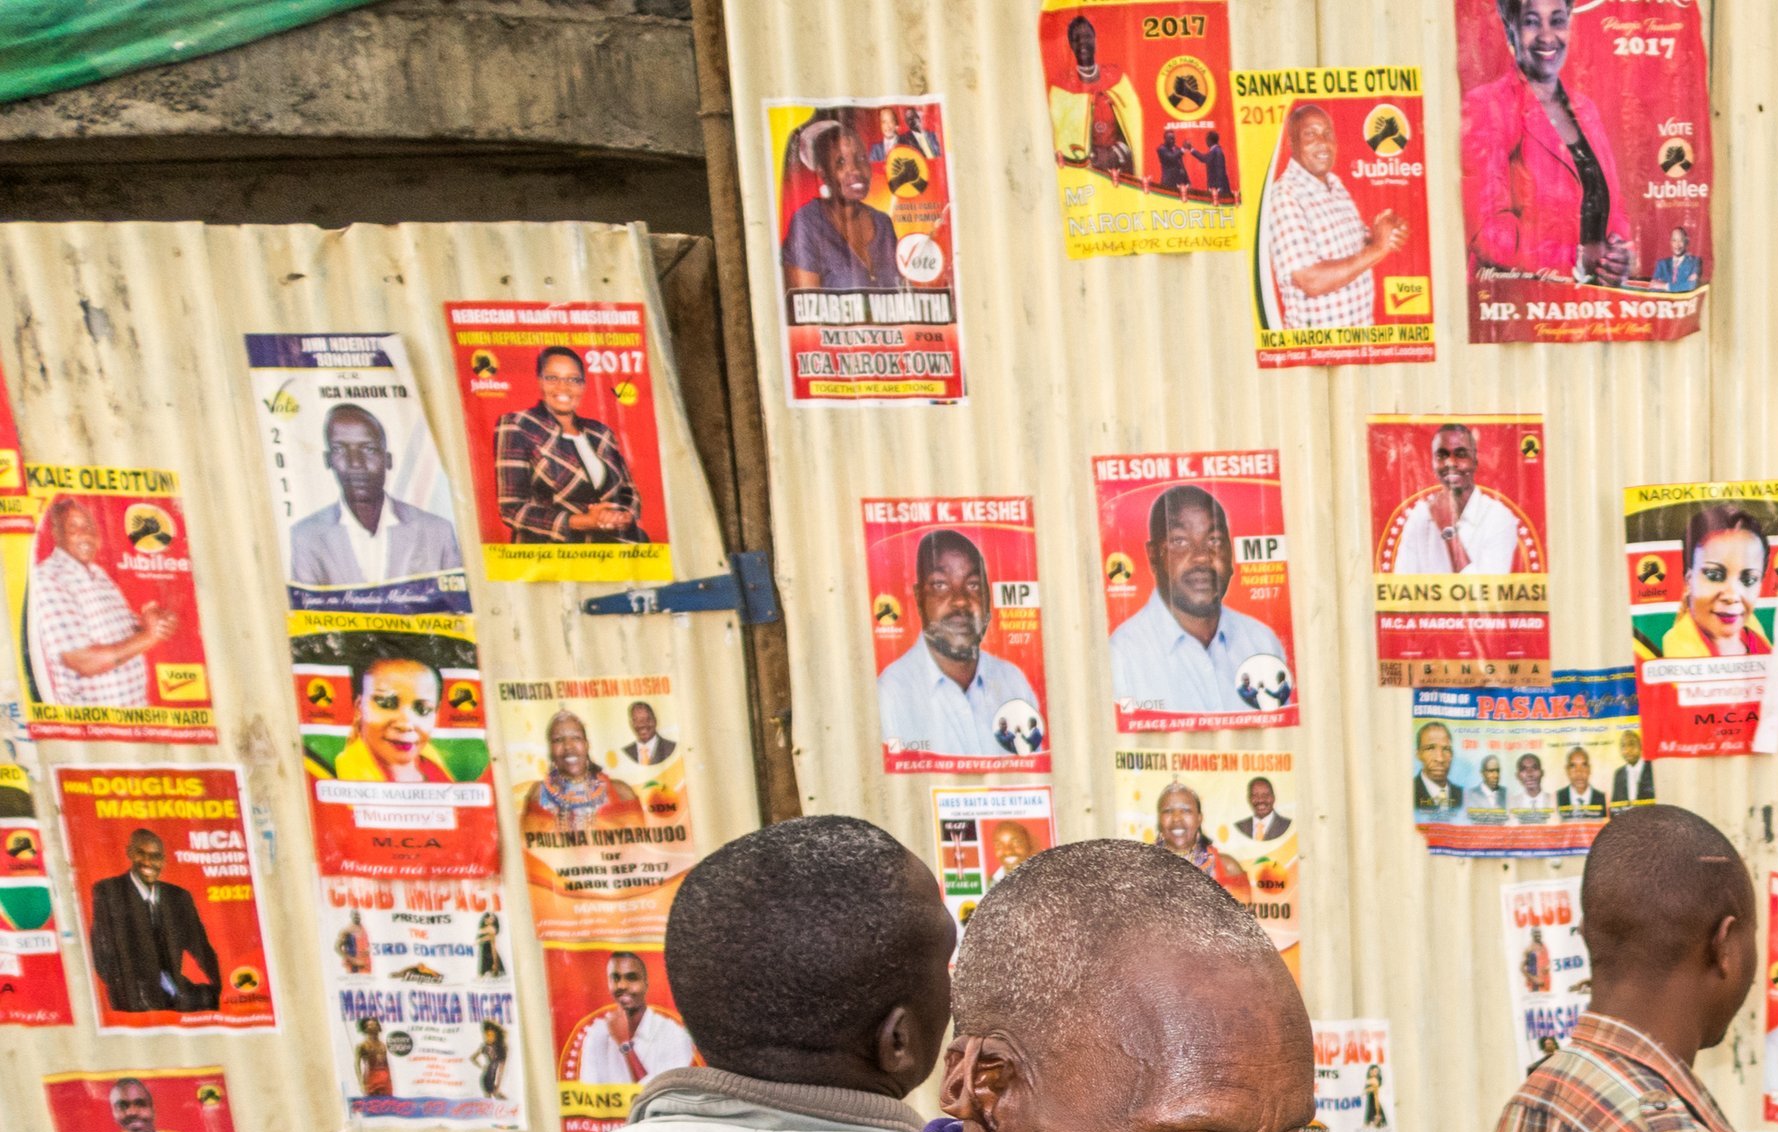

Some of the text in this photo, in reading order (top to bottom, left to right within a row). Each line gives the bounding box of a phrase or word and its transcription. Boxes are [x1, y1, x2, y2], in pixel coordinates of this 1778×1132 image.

[1143, 15, 1206, 39] 2017
[1612, 37, 1676, 59] 2017
[1235, 68, 1418, 98] SANKALE OLE OTUNI
[1240, 105, 1285, 125] 2017
[1164, 120, 1216, 131] JUBILEE
[1657, 117, 1694, 137] VOTE
[1351, 157, 1424, 178] Jubilee
[1065, 185, 1096, 208] MP
[1643, 180, 1709, 199] Jubilee
[1068, 207, 1236, 238] NAROK NORTH
[1396, 282, 1423, 294] Vote
[1479, 298, 1699, 322] MP. NAROK NORTH
[821, 330, 944, 348] MUNYUA FOR
[1260, 325, 1430, 348] MCA NAROK TOWNSHIP WARD
[585, 350, 645, 373] 2017
[1097, 453, 1275, 481] NELSON K. KESHEI
[864, 499, 1028, 524] NELSON K. KESHEI
[1243, 537, 1279, 561] MP
[117, 553, 191, 572] Jubilee
[1002, 583, 1031, 605] MP
[1249, 586, 1281, 600] 2017
[1376, 583, 1546, 602] EVANS OLE MASI
[1380, 616, 1545, 630] M.C.A NAROK TOWN WARD
[167, 668, 198, 681] Vote
[1707, 660, 1766, 675] MAUREEN
[1476, 694, 1591, 720] PASAKA
[1128, 713, 1286, 730] PEACE AND DEVELOPMENT
[1694, 712, 1759, 725] M.C.A
[1115, 751, 1292, 772] ENDUATA EWANG'AN OLOSHO
[320, 785, 486, 801] FLORENCE MAUREEN SETH
[96, 799, 239, 819] MASIKONDE
[189, 831, 243, 850] MCA
[174, 851, 246, 864] TOWNSHIP
[202, 865, 248, 878] WARD
[556, 861, 669, 878] WOMEN REP 2017
[207, 884, 251, 902] 2017
[564, 876, 665, 892] NAROK COUNTY
[1256, 880, 1285, 890] ODM
[1513, 889, 1573, 928] CLUB
[391, 913, 453, 924] PRESENTS
[409, 929, 429, 940] THE
[413, 943, 475, 957] EDITION
[1553, 954, 1585, 972] 3RD
[407, 991, 464, 1025] SHUKA
[561, 1089, 623, 1109] EVANS
